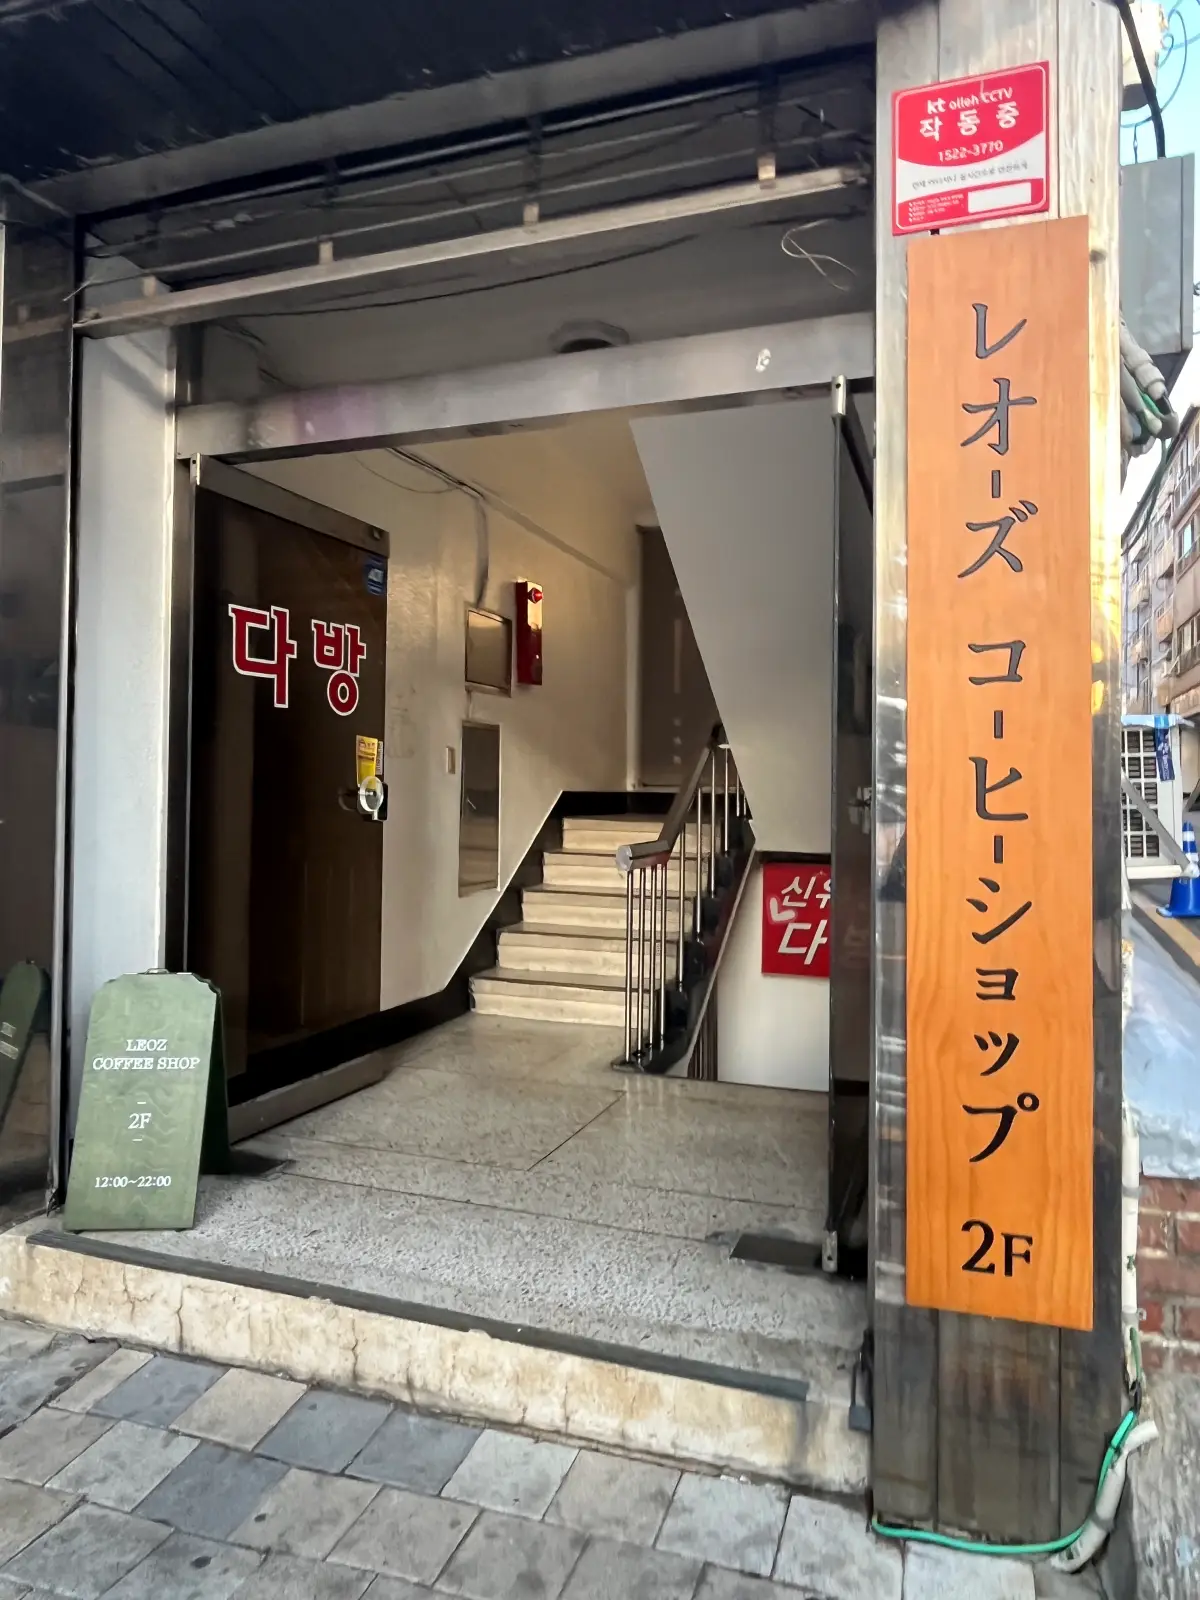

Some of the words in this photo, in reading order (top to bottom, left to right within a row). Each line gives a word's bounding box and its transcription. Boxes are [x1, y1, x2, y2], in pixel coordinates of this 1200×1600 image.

[938, 140, 1004, 162] 1522-3770
[957, 303, 1039, 579] レオーズ
[228, 603, 367, 717] 다방
[126, 1039, 168, 1052] LEOZ
[92, 1057, 154, 1071] COFFEE
[156, 1056, 201, 1070] SHOP
[127, 1112, 152, 1130] 2F
[94, 1175, 172, 1188] 12:00~22:00
[961, 1218, 1034, 1278] 2F
